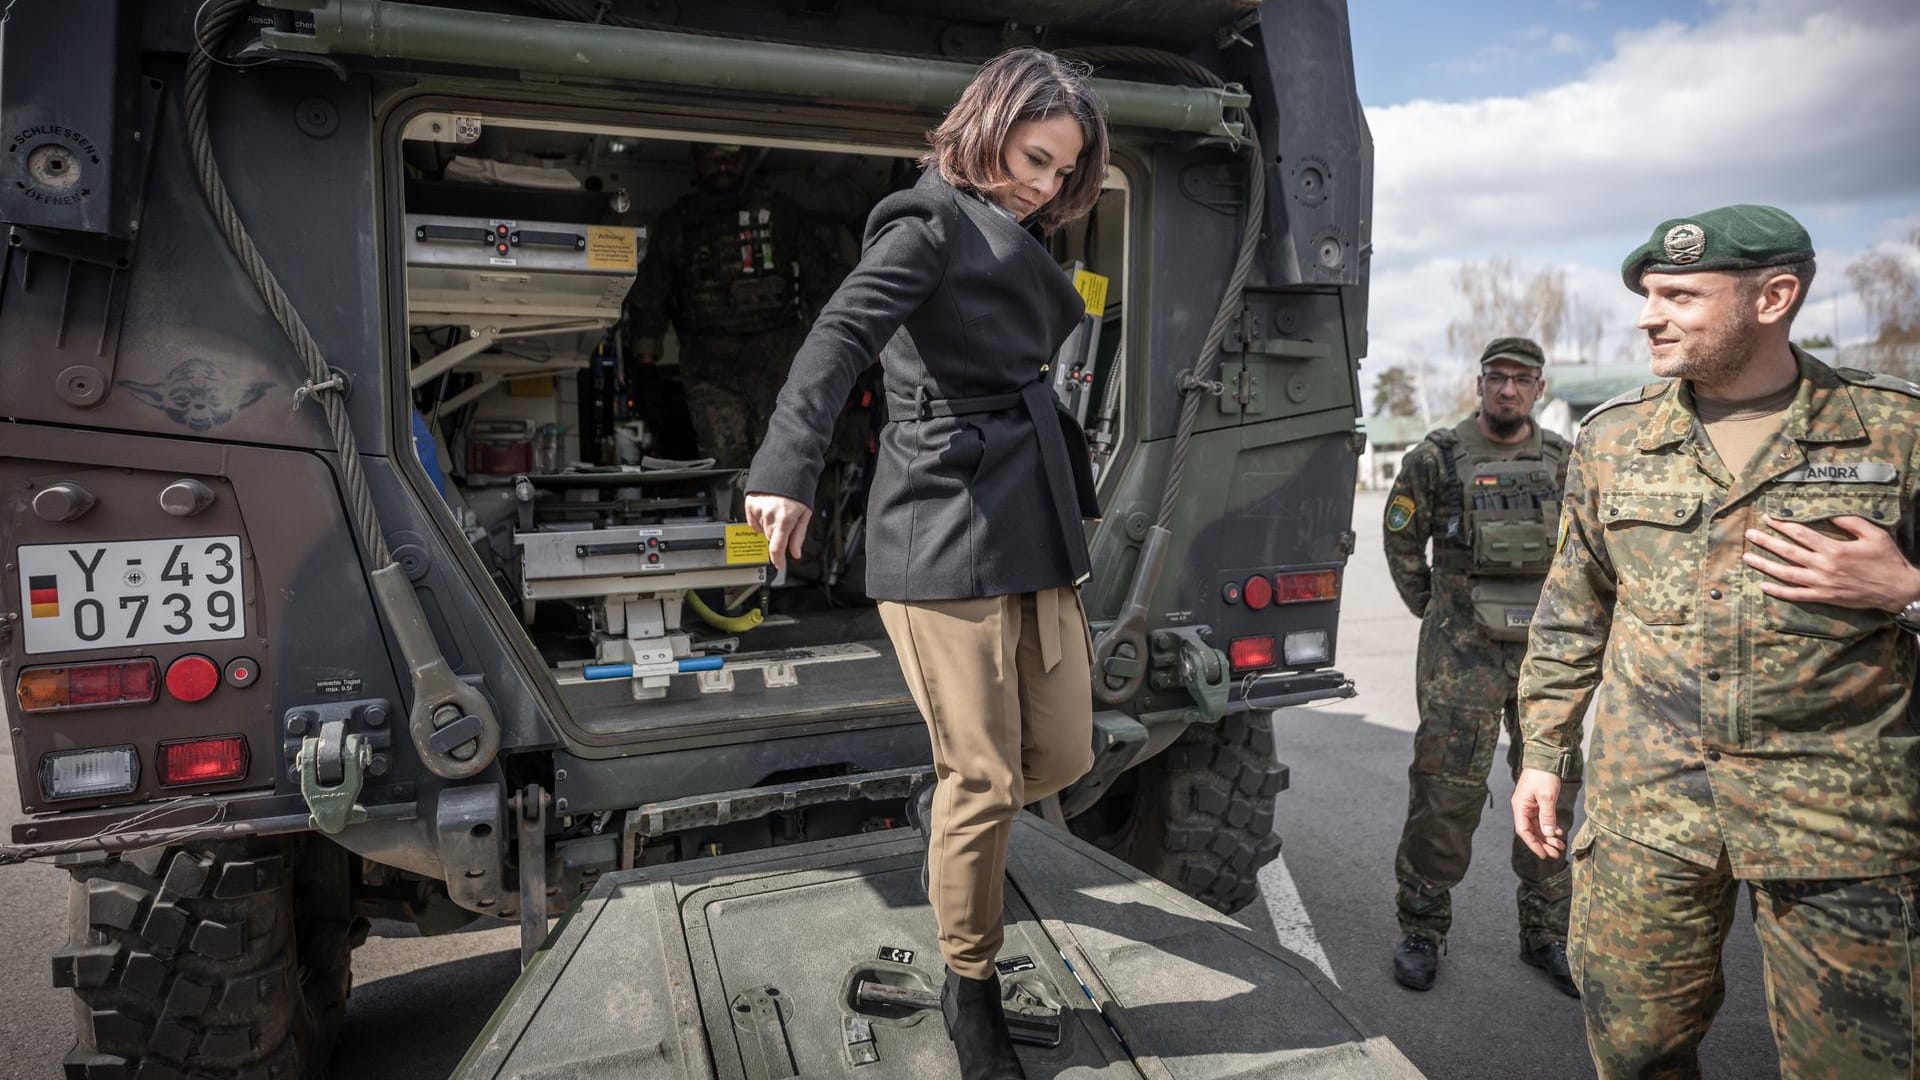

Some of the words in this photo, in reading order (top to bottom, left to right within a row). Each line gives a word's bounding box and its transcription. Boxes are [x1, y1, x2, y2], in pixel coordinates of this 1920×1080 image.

[15, 125, 96, 154] SCHLIESSEN
[1807, 465, 1858, 479] ANDRÄ
[74, 590, 236, 642] 0739
